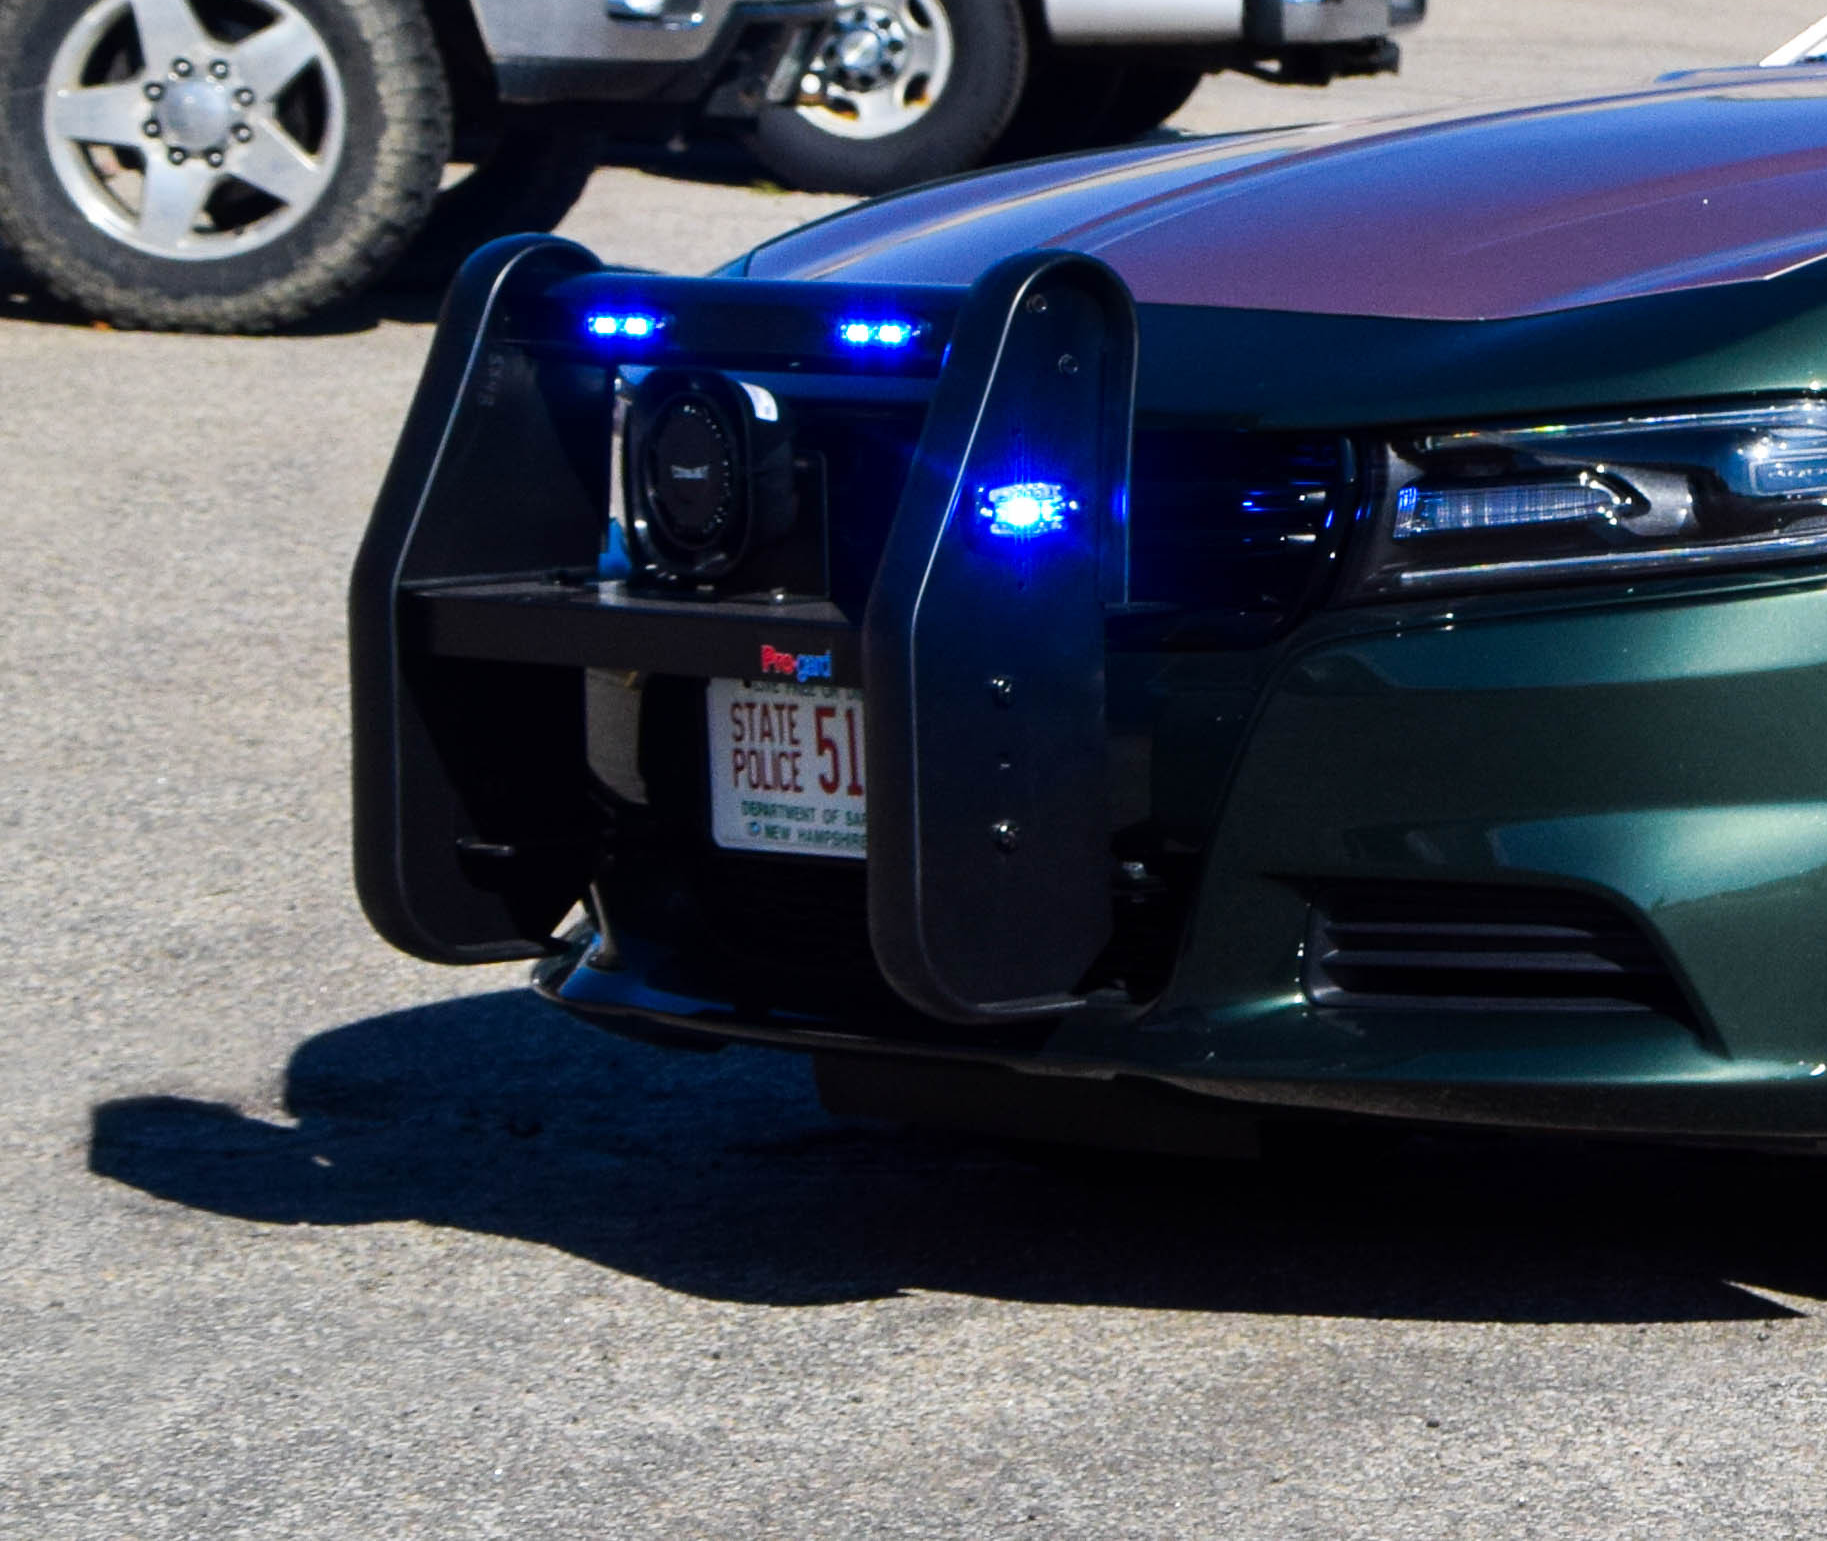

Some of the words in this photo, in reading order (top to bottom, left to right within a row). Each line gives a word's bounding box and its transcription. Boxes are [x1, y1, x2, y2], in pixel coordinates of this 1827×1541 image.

[731, 701, 802, 746] STATE
[814, 706, 864, 797] 51
[732, 747, 803, 794] POLICE
[741, 799, 816, 824] DEPARTMENT
[822, 809, 838, 825] OF
[763, 823, 790, 842] NEW
